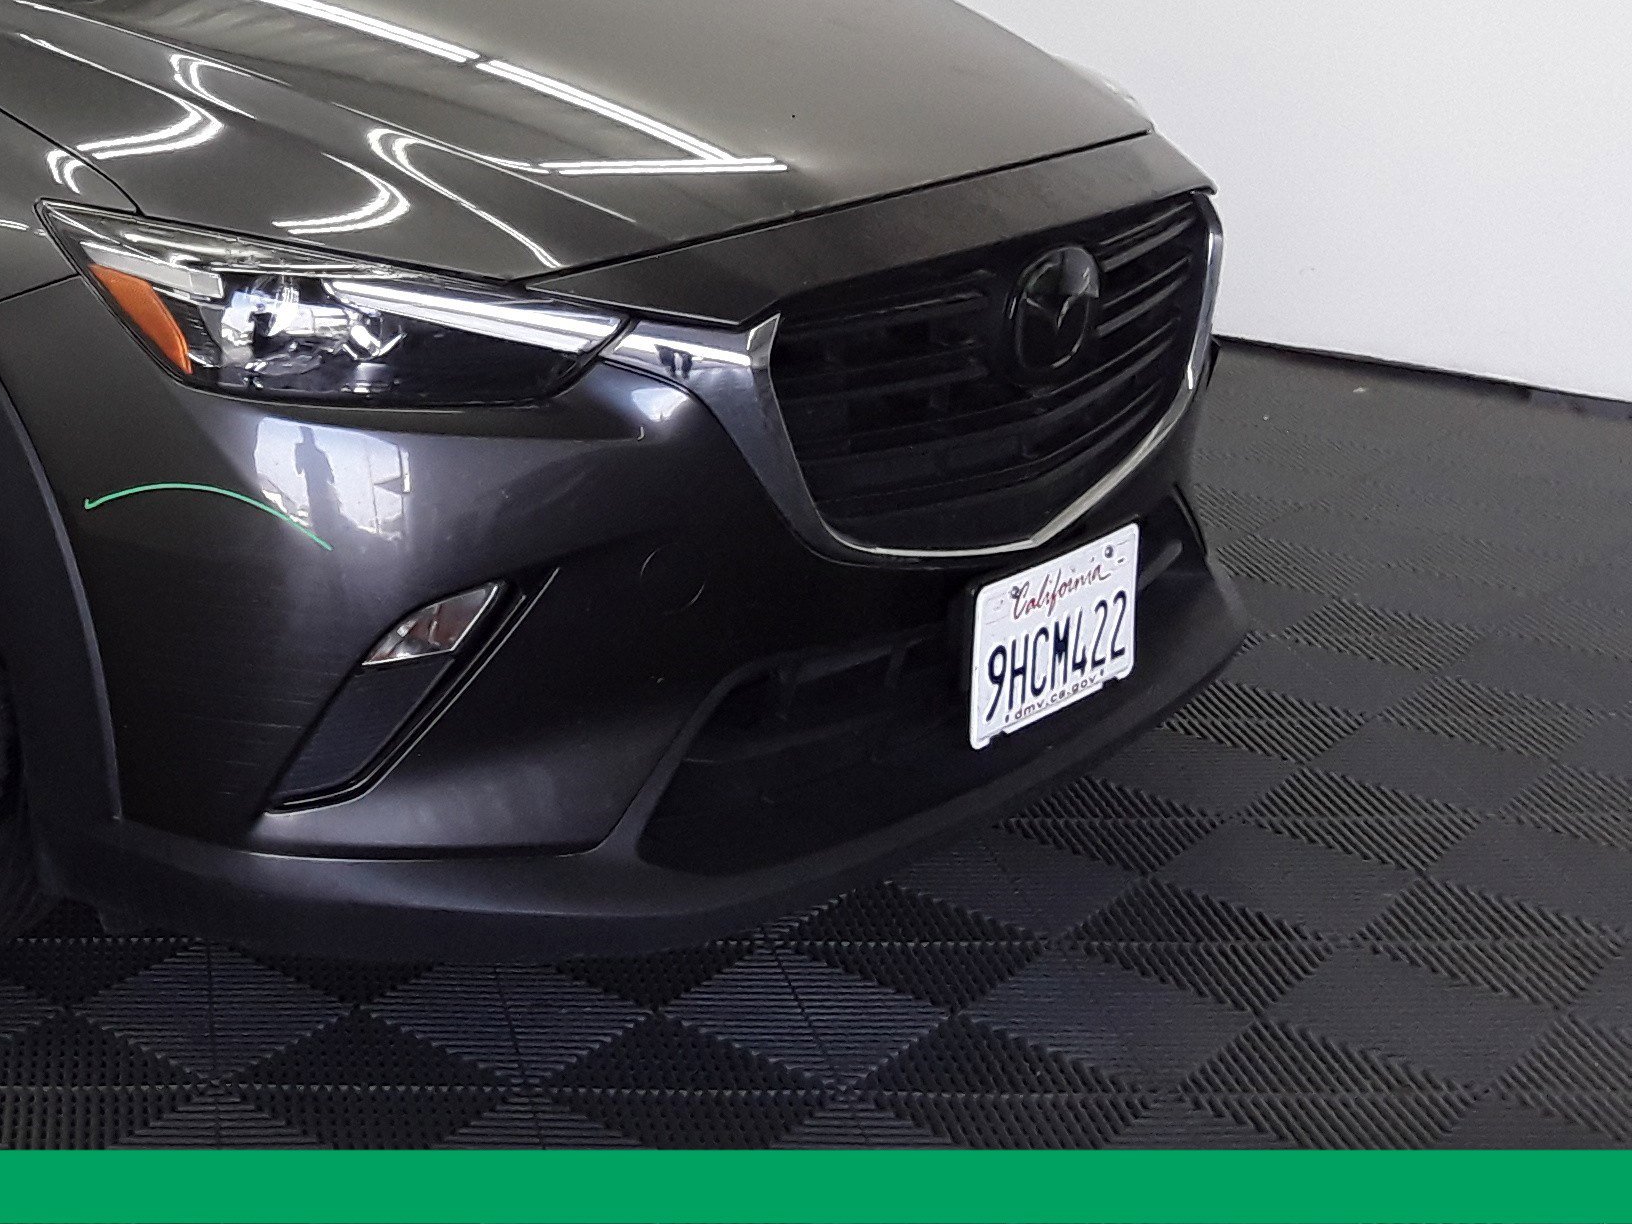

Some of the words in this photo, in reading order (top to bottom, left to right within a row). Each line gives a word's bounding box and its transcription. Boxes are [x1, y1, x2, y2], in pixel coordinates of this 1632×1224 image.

[1011, 564, 1111, 620] California
[986, 590, 1127, 722] 9HCM422
[1015, 675, 1096, 719] dmv.ca.gov
